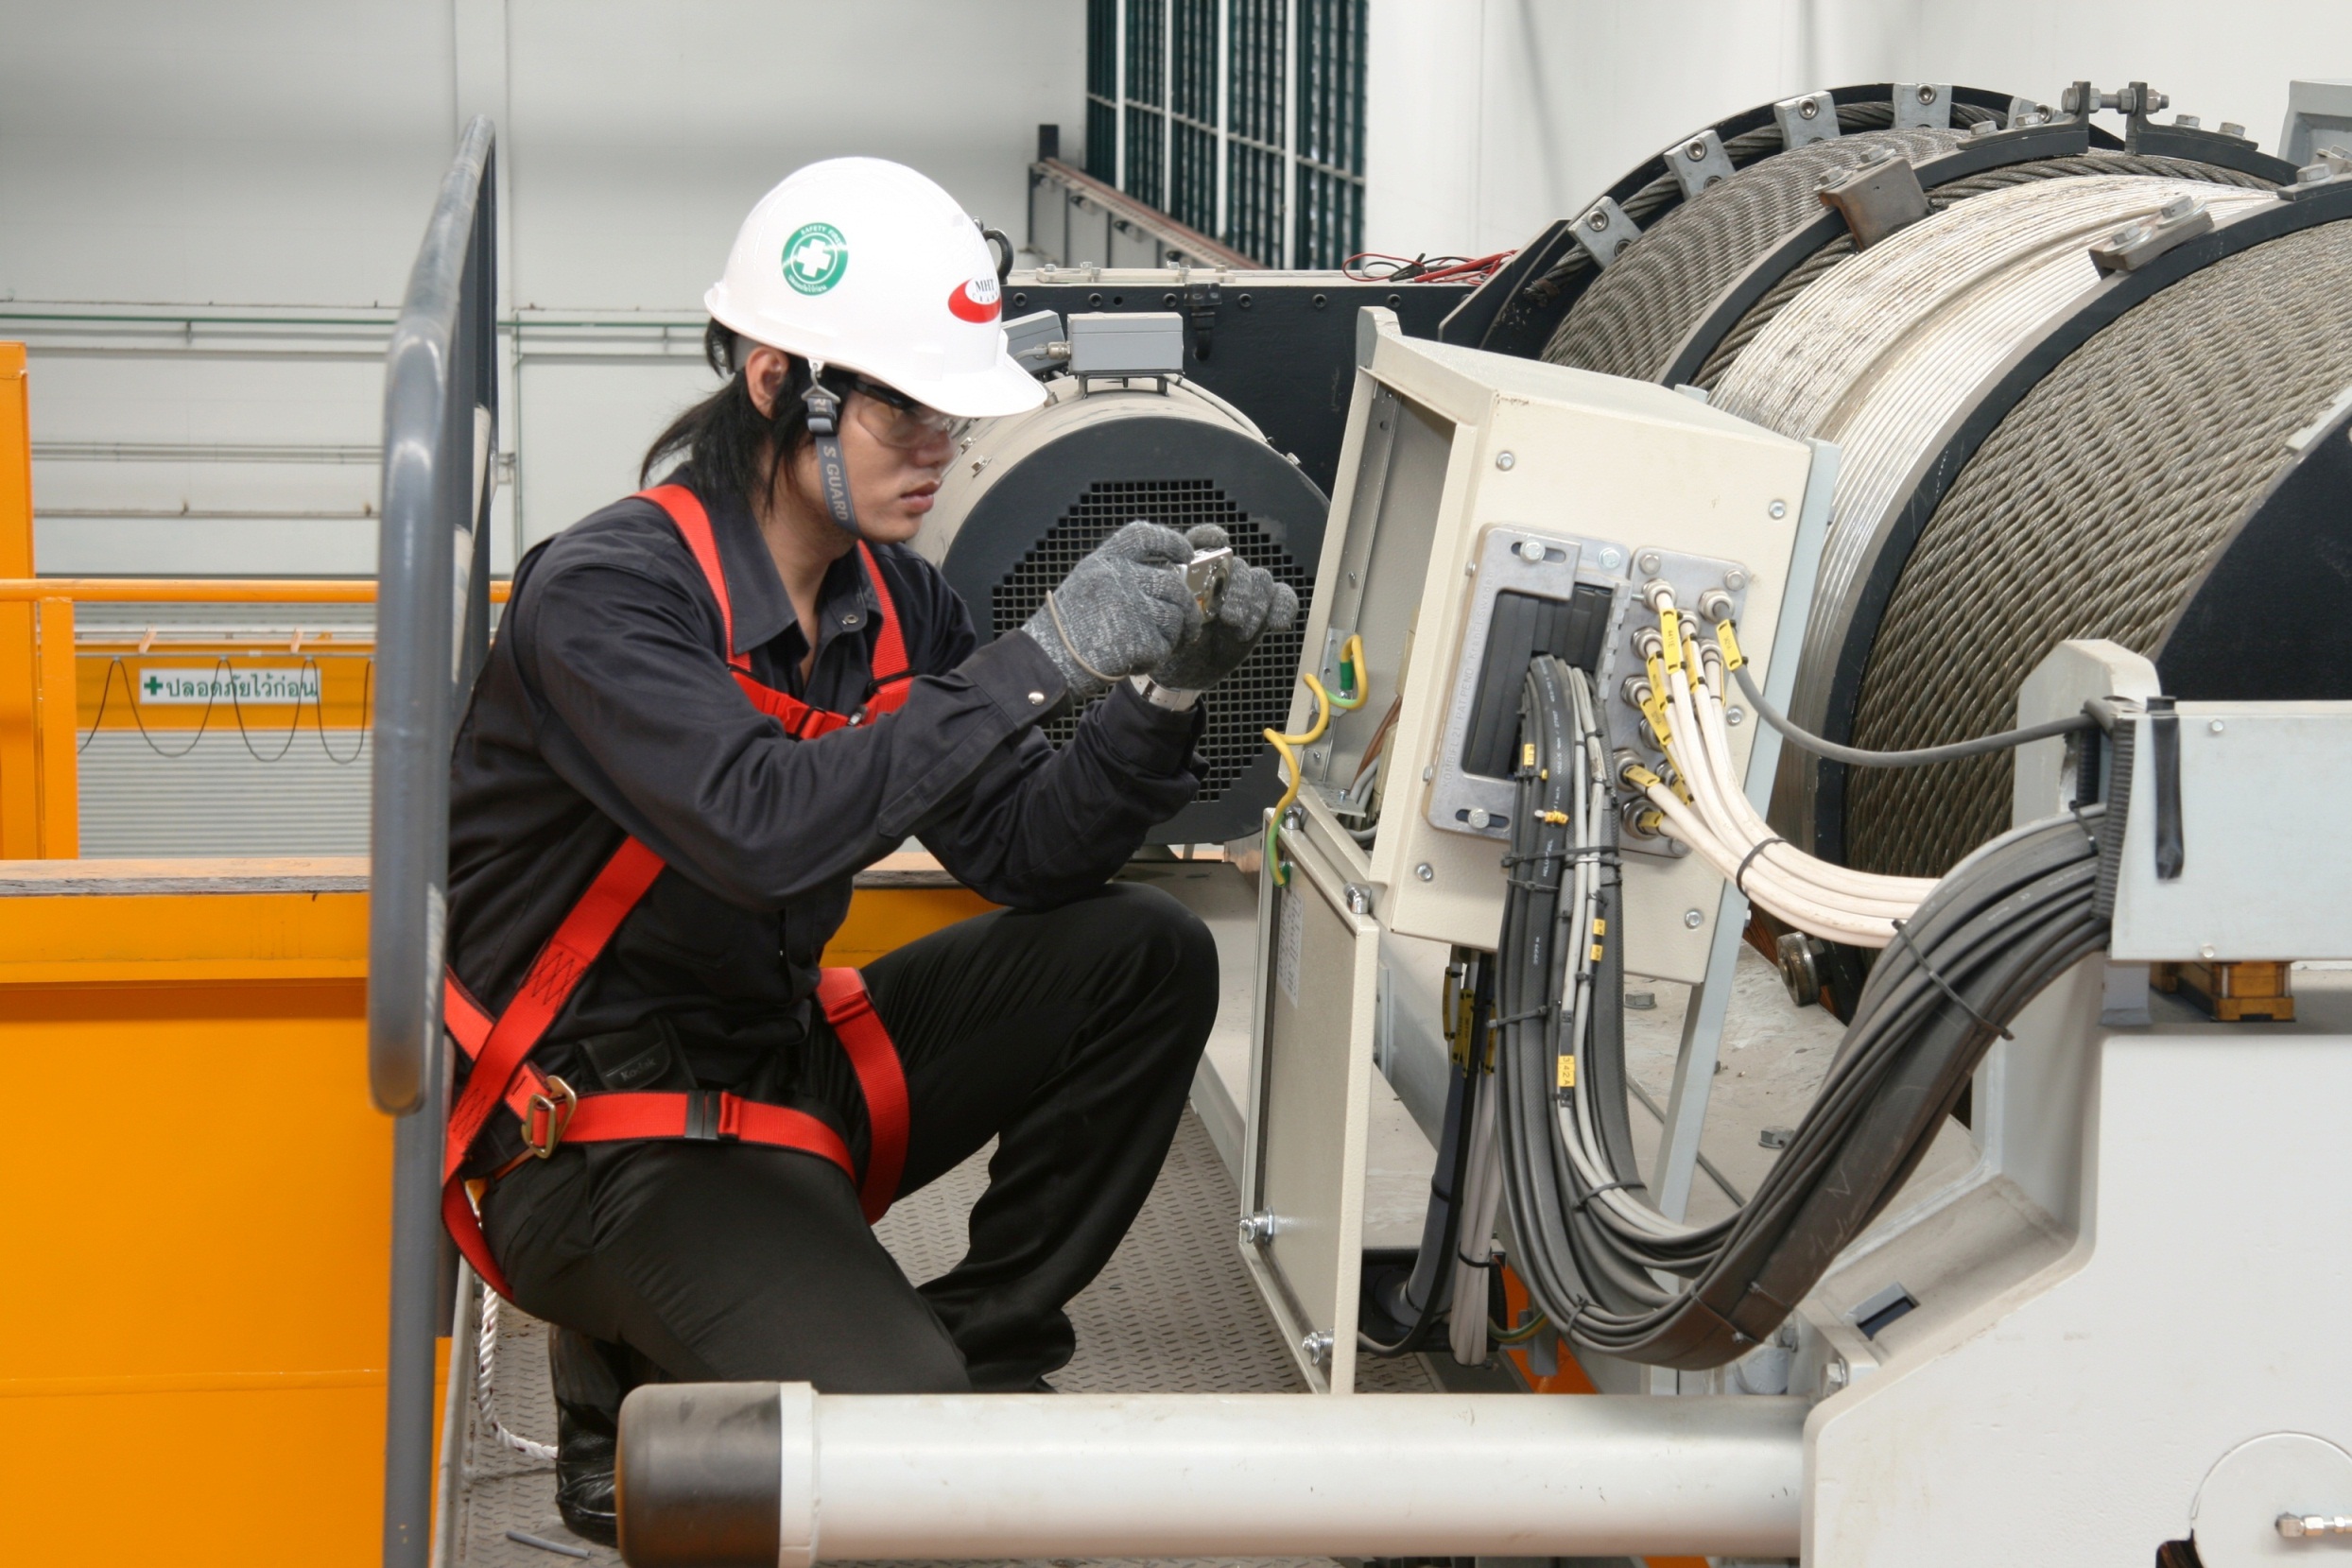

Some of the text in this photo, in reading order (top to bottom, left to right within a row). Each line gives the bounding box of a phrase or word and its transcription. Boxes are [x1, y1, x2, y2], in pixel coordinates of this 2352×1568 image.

[801, 224, 827, 236] SAFETY
[975, 278, 995, 292] MHT
[826, 463, 849, 521] GUARD
[165, 673, 318, 698] ปลอดภัยไว้ก่อน
[1562, 1056, 1571, 1086] 342A
